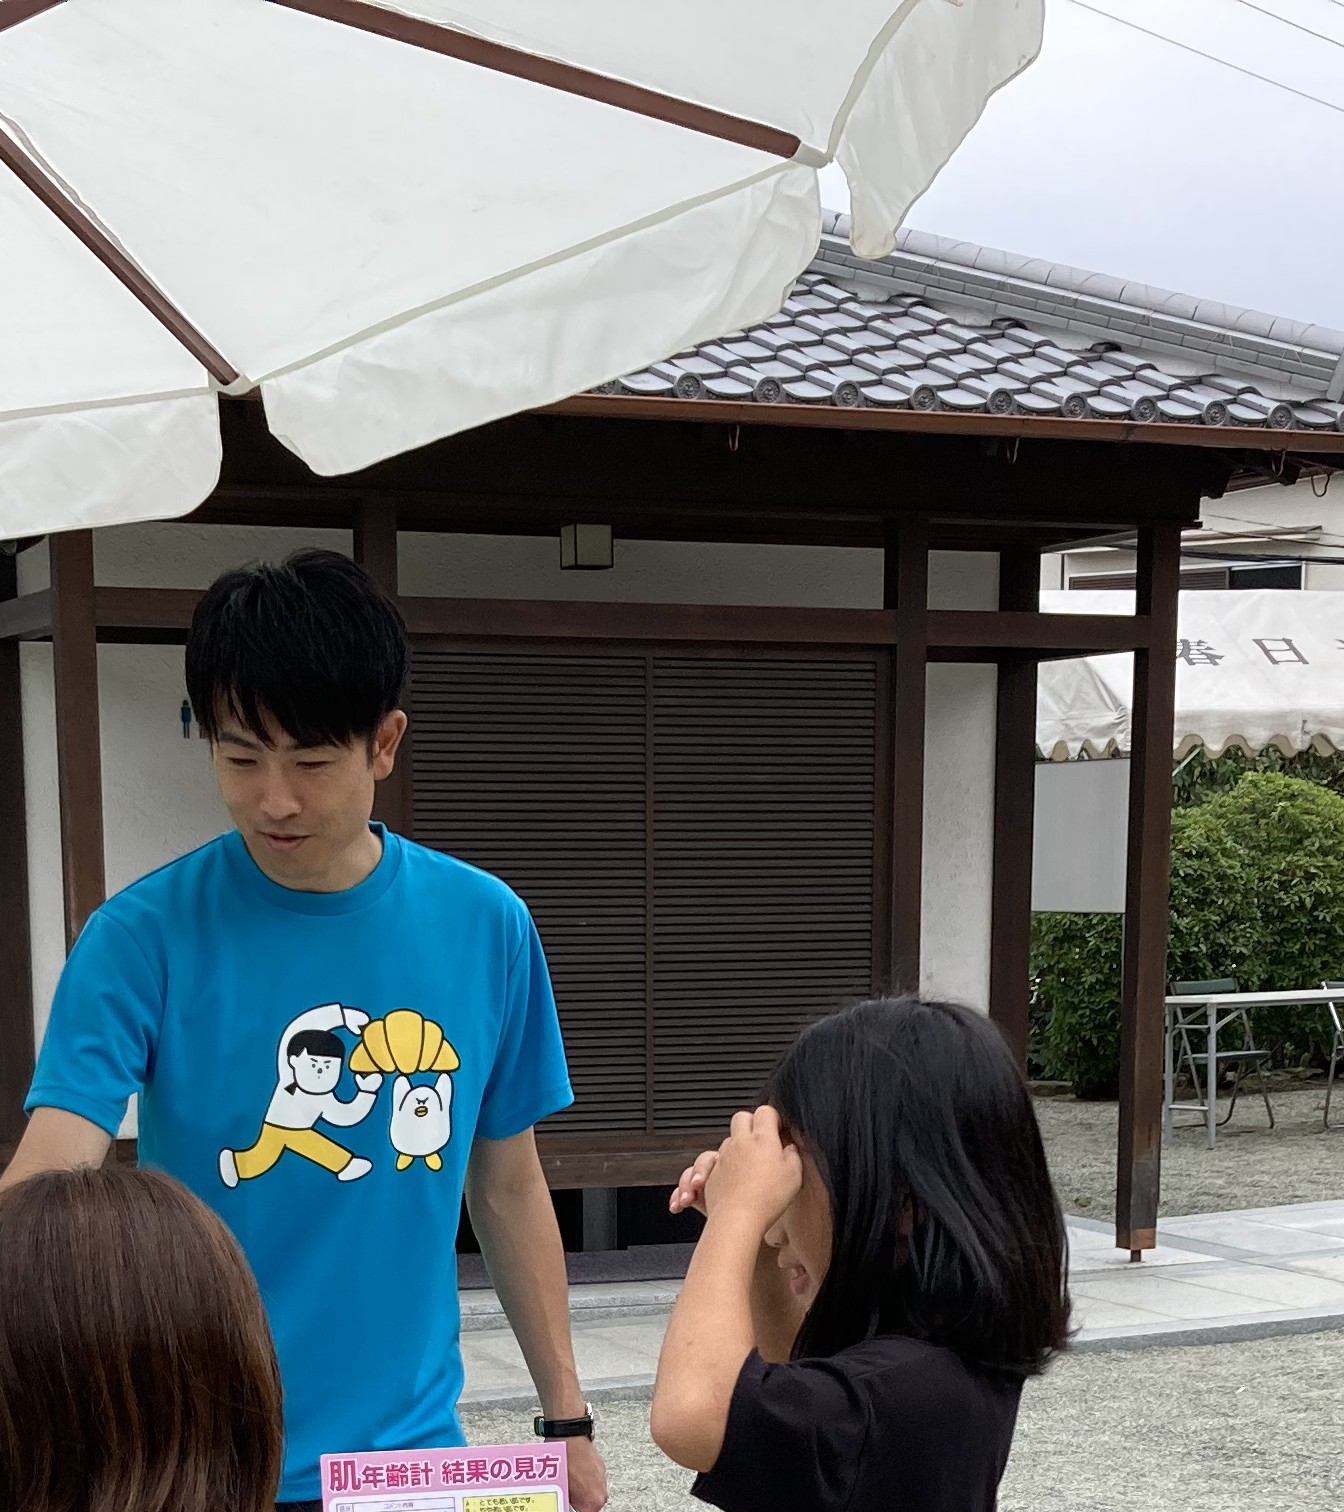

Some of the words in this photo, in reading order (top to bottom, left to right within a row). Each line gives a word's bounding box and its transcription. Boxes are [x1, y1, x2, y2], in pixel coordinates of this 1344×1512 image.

[329, 1460, 432, 1491] 肌年齢計
[442, 1455, 559, 1485] 結果の見方
